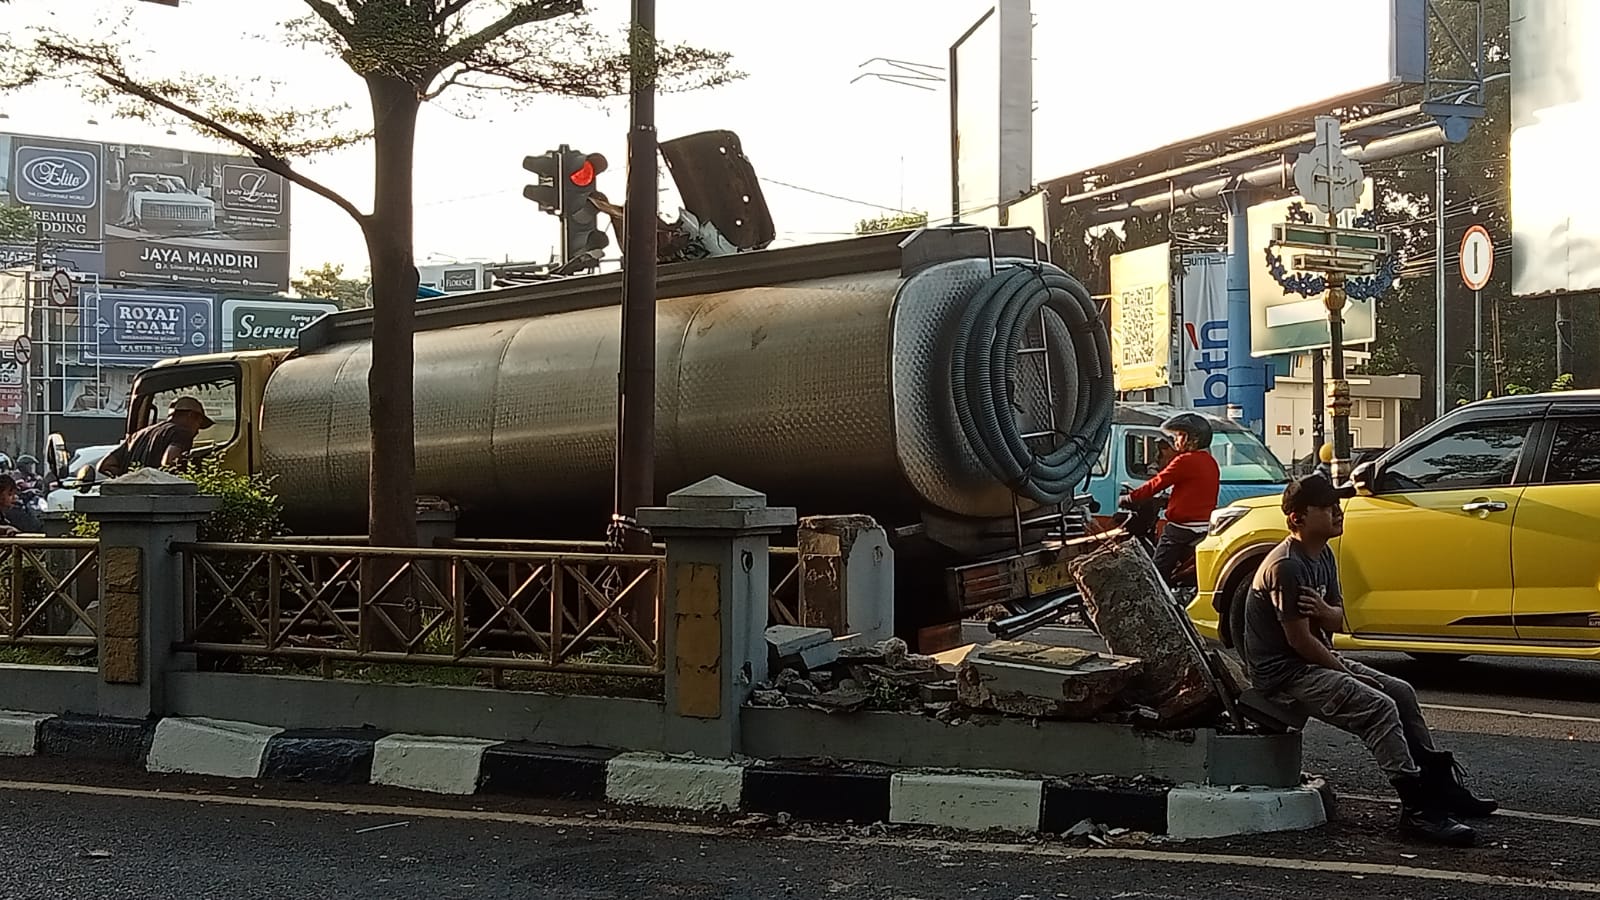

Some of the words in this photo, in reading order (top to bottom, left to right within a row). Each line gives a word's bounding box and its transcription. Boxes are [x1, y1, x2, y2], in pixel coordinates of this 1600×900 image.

[32, 161, 80, 186] Elite
[33, 210, 86, 224] REMIUM
[140, 248, 183, 263] JAYA
[188, 251, 258, 269] MANDIRI
[446, 279, 473, 287] FLORENCE
[120, 306, 178, 321] ROYAL
[125, 320, 176, 335] FOAM
[120, 345, 153, 353] KASUR
[155, 346, 180, 354] BUSA
[1193, 321, 1229, 407] btn
